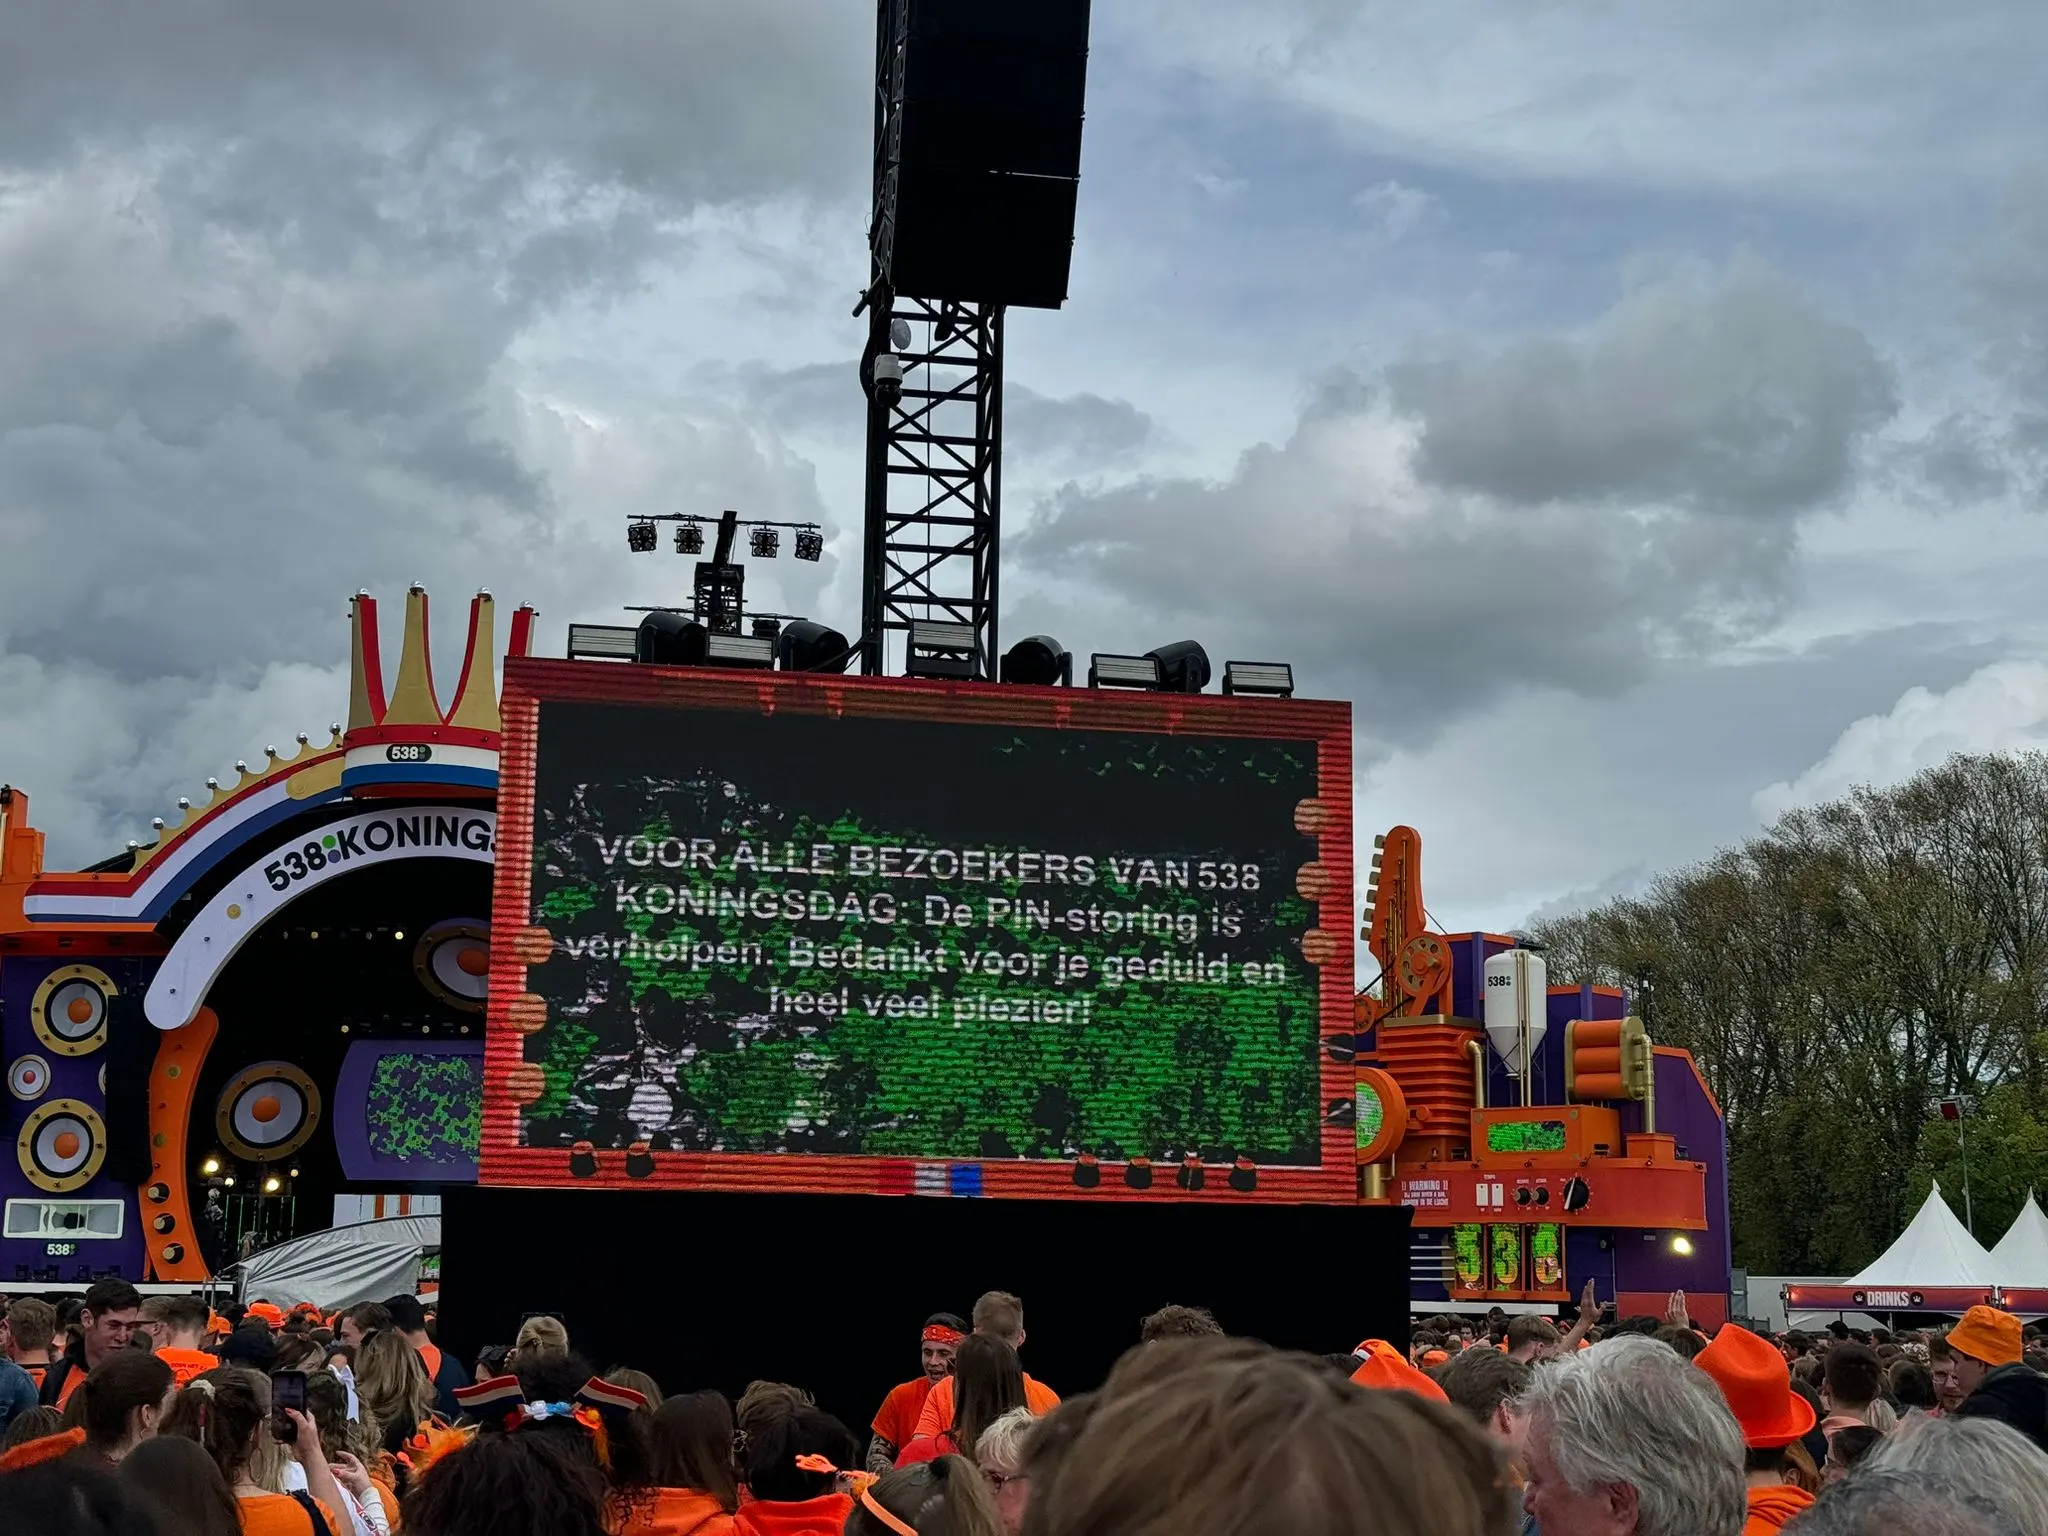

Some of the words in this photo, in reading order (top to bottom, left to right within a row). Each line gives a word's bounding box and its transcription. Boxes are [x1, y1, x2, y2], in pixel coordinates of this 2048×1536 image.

[336, 815, 496, 858] KONING
[597, 835, 717, 870] VOOR
[730, 840, 835, 875] ALLE
[850, 846, 1096, 886] BEZOEKERS
[1108, 856, 1189, 888] VAN
[1198, 862, 1261, 891] 538
[616, 881, 909, 924] KONINGSDAG:
[925, 895, 973, 927] De
[987, 898, 1197, 944] PIN-storing
[1212, 900, 1241, 938] is
[564, 931, 773, 971] verholpen.
[789, 936, 948, 972] Bedankt
[960, 950, 1047, 976] voor
[1054, 946, 1089, 985] je
[1101, 951, 1229, 987] geduld
[1241, 961, 1285, 984] en
[770, 986, 847, 1015] heel
[863, 987, 939, 1018] veel
[953, 993, 1090, 1028] plezier!
[1409, 1180, 1440, 1191] WARNING
[1866, 1291, 1910, 1307] DRINKS
